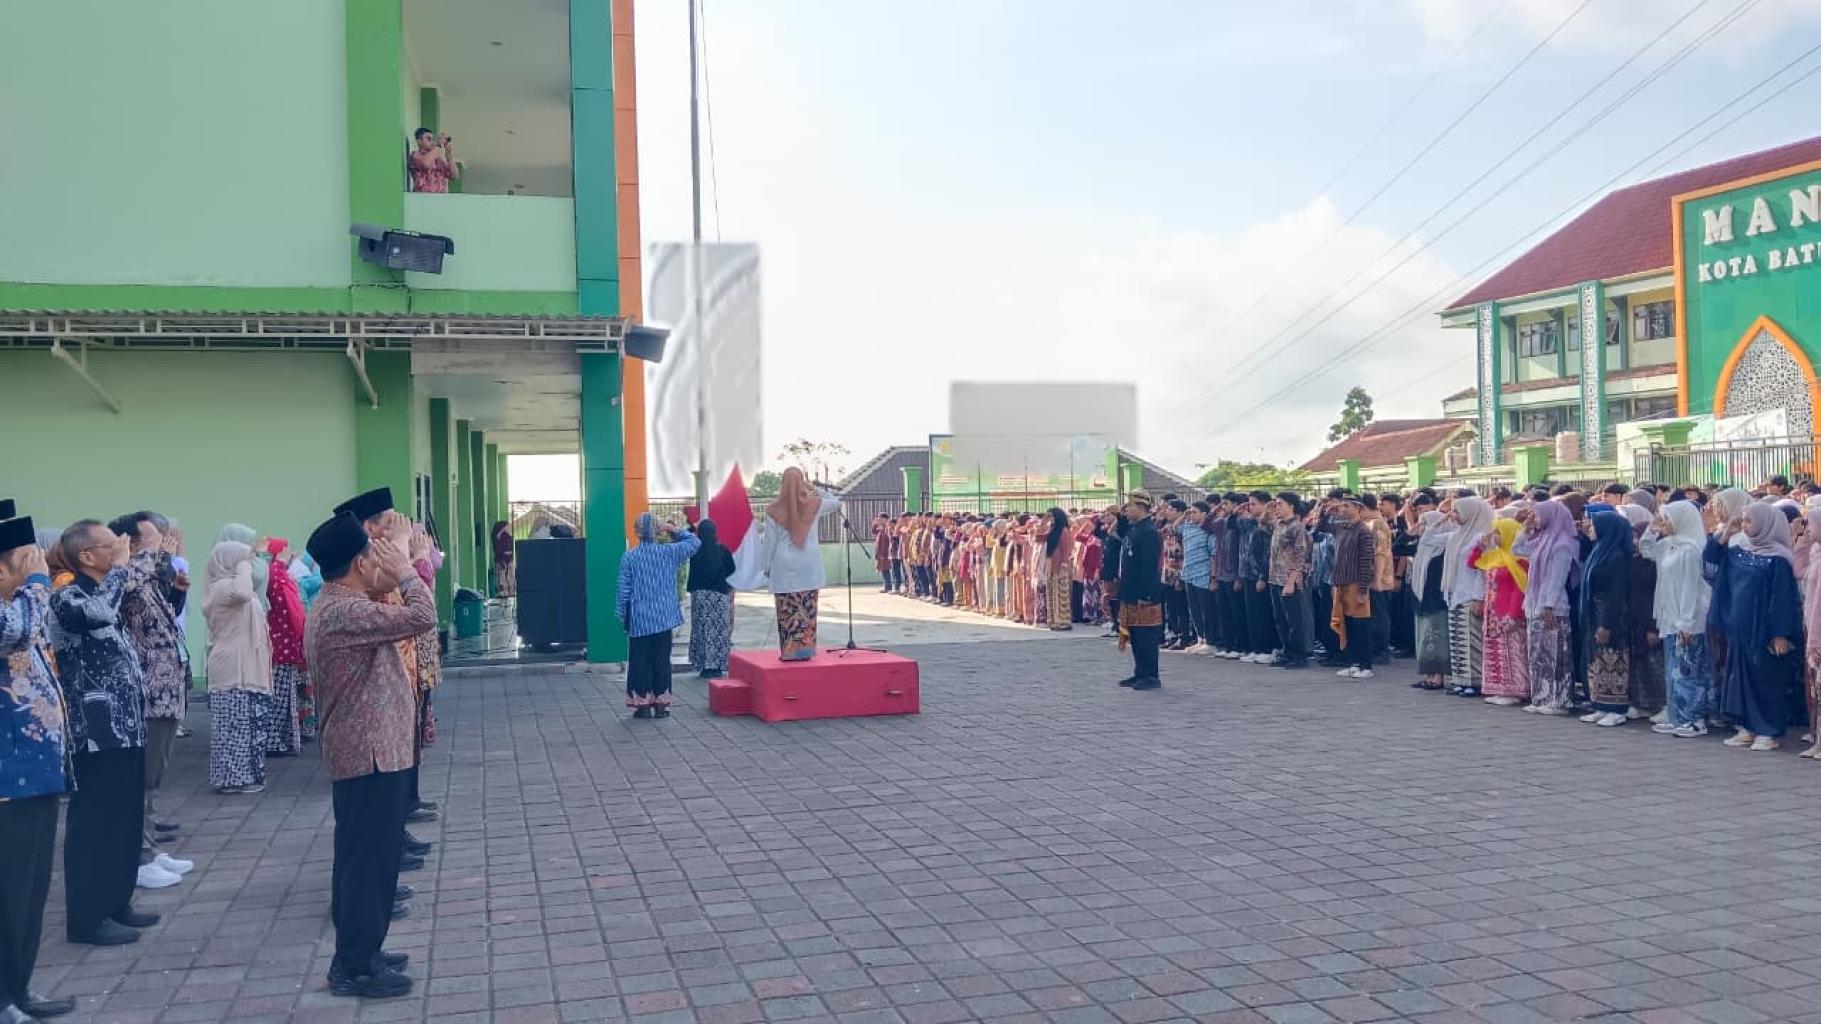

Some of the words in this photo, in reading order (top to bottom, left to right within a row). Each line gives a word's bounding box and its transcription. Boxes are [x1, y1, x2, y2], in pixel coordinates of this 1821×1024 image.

[1702, 184, 1821, 246] MAN
[1698, 254, 1758, 283] KOTA
[1767, 241, 1821, 270] BAT
